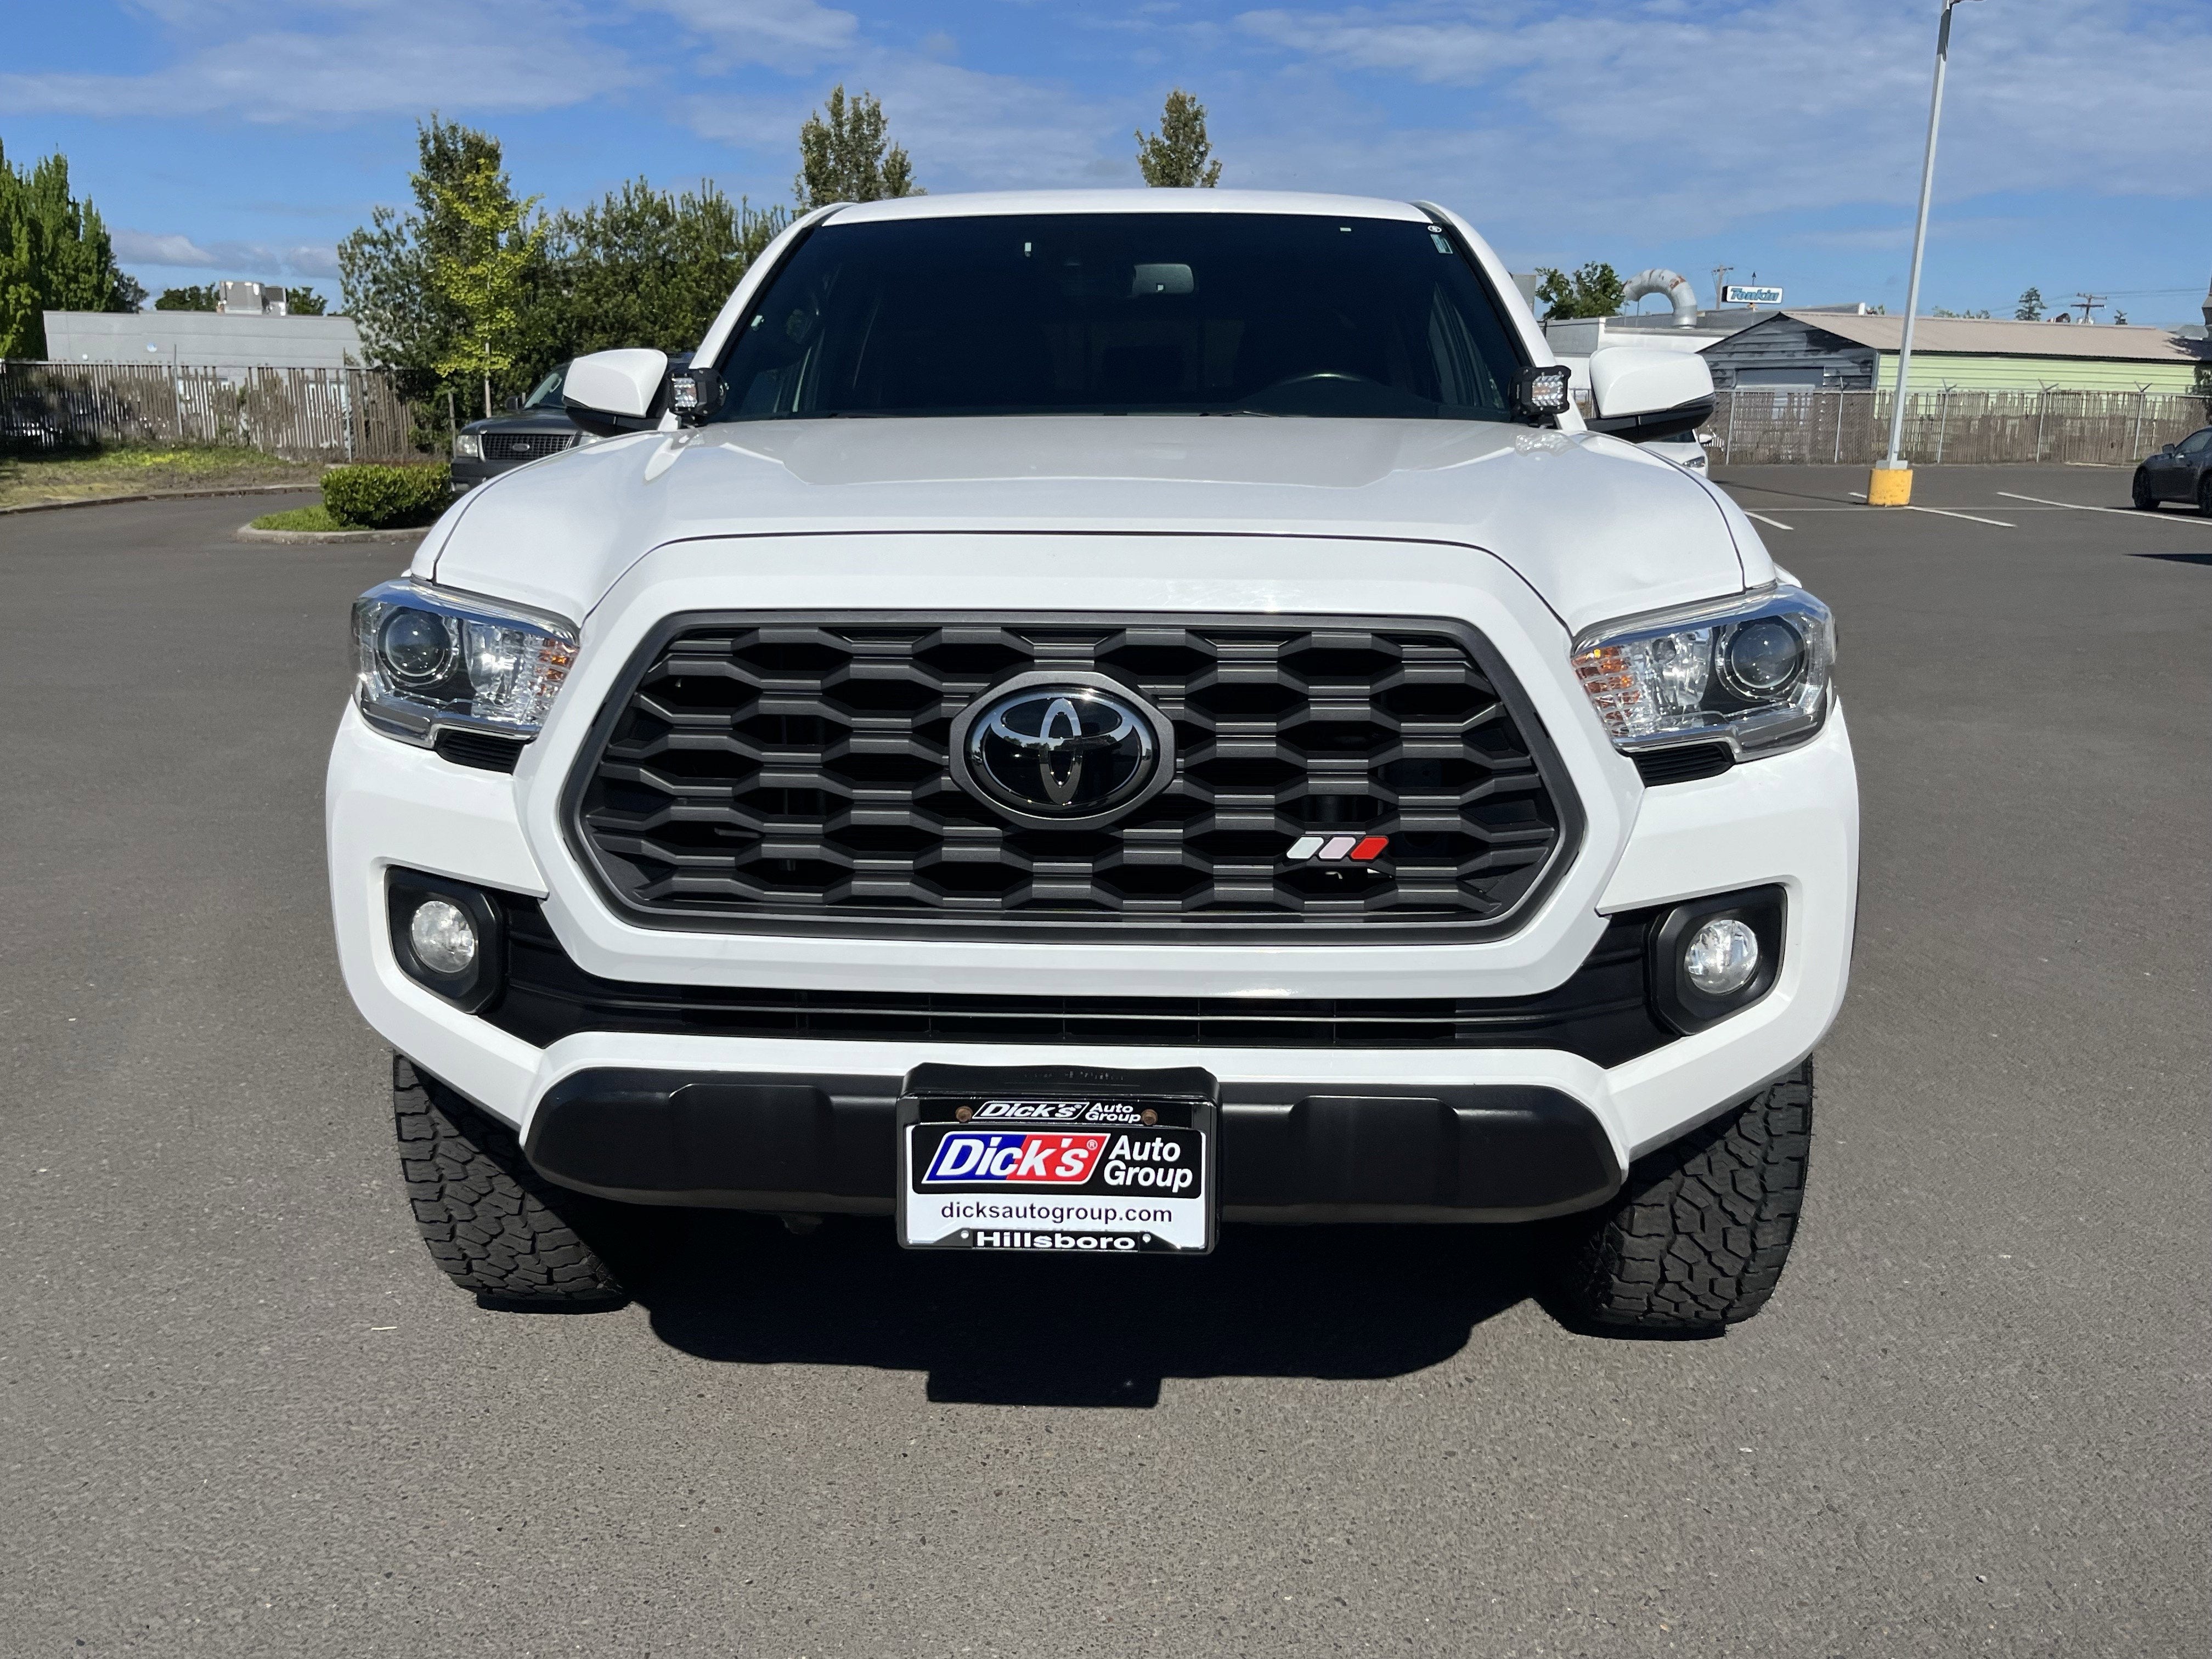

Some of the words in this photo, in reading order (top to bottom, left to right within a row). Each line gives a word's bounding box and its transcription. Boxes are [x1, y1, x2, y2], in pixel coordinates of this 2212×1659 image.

[1731, 288, 1779, 301] Tonkin
[1085, 1111, 1141, 1124] Group
[1088, 1103, 1133, 1113] Auto
[1108, 1135, 1181, 1162] Auto
[1104, 1160, 1193, 1193] Group
[941, 1201, 1172, 1224] dicksautogroup.com
[977, 1231, 1136, 1250] Hillsboro
